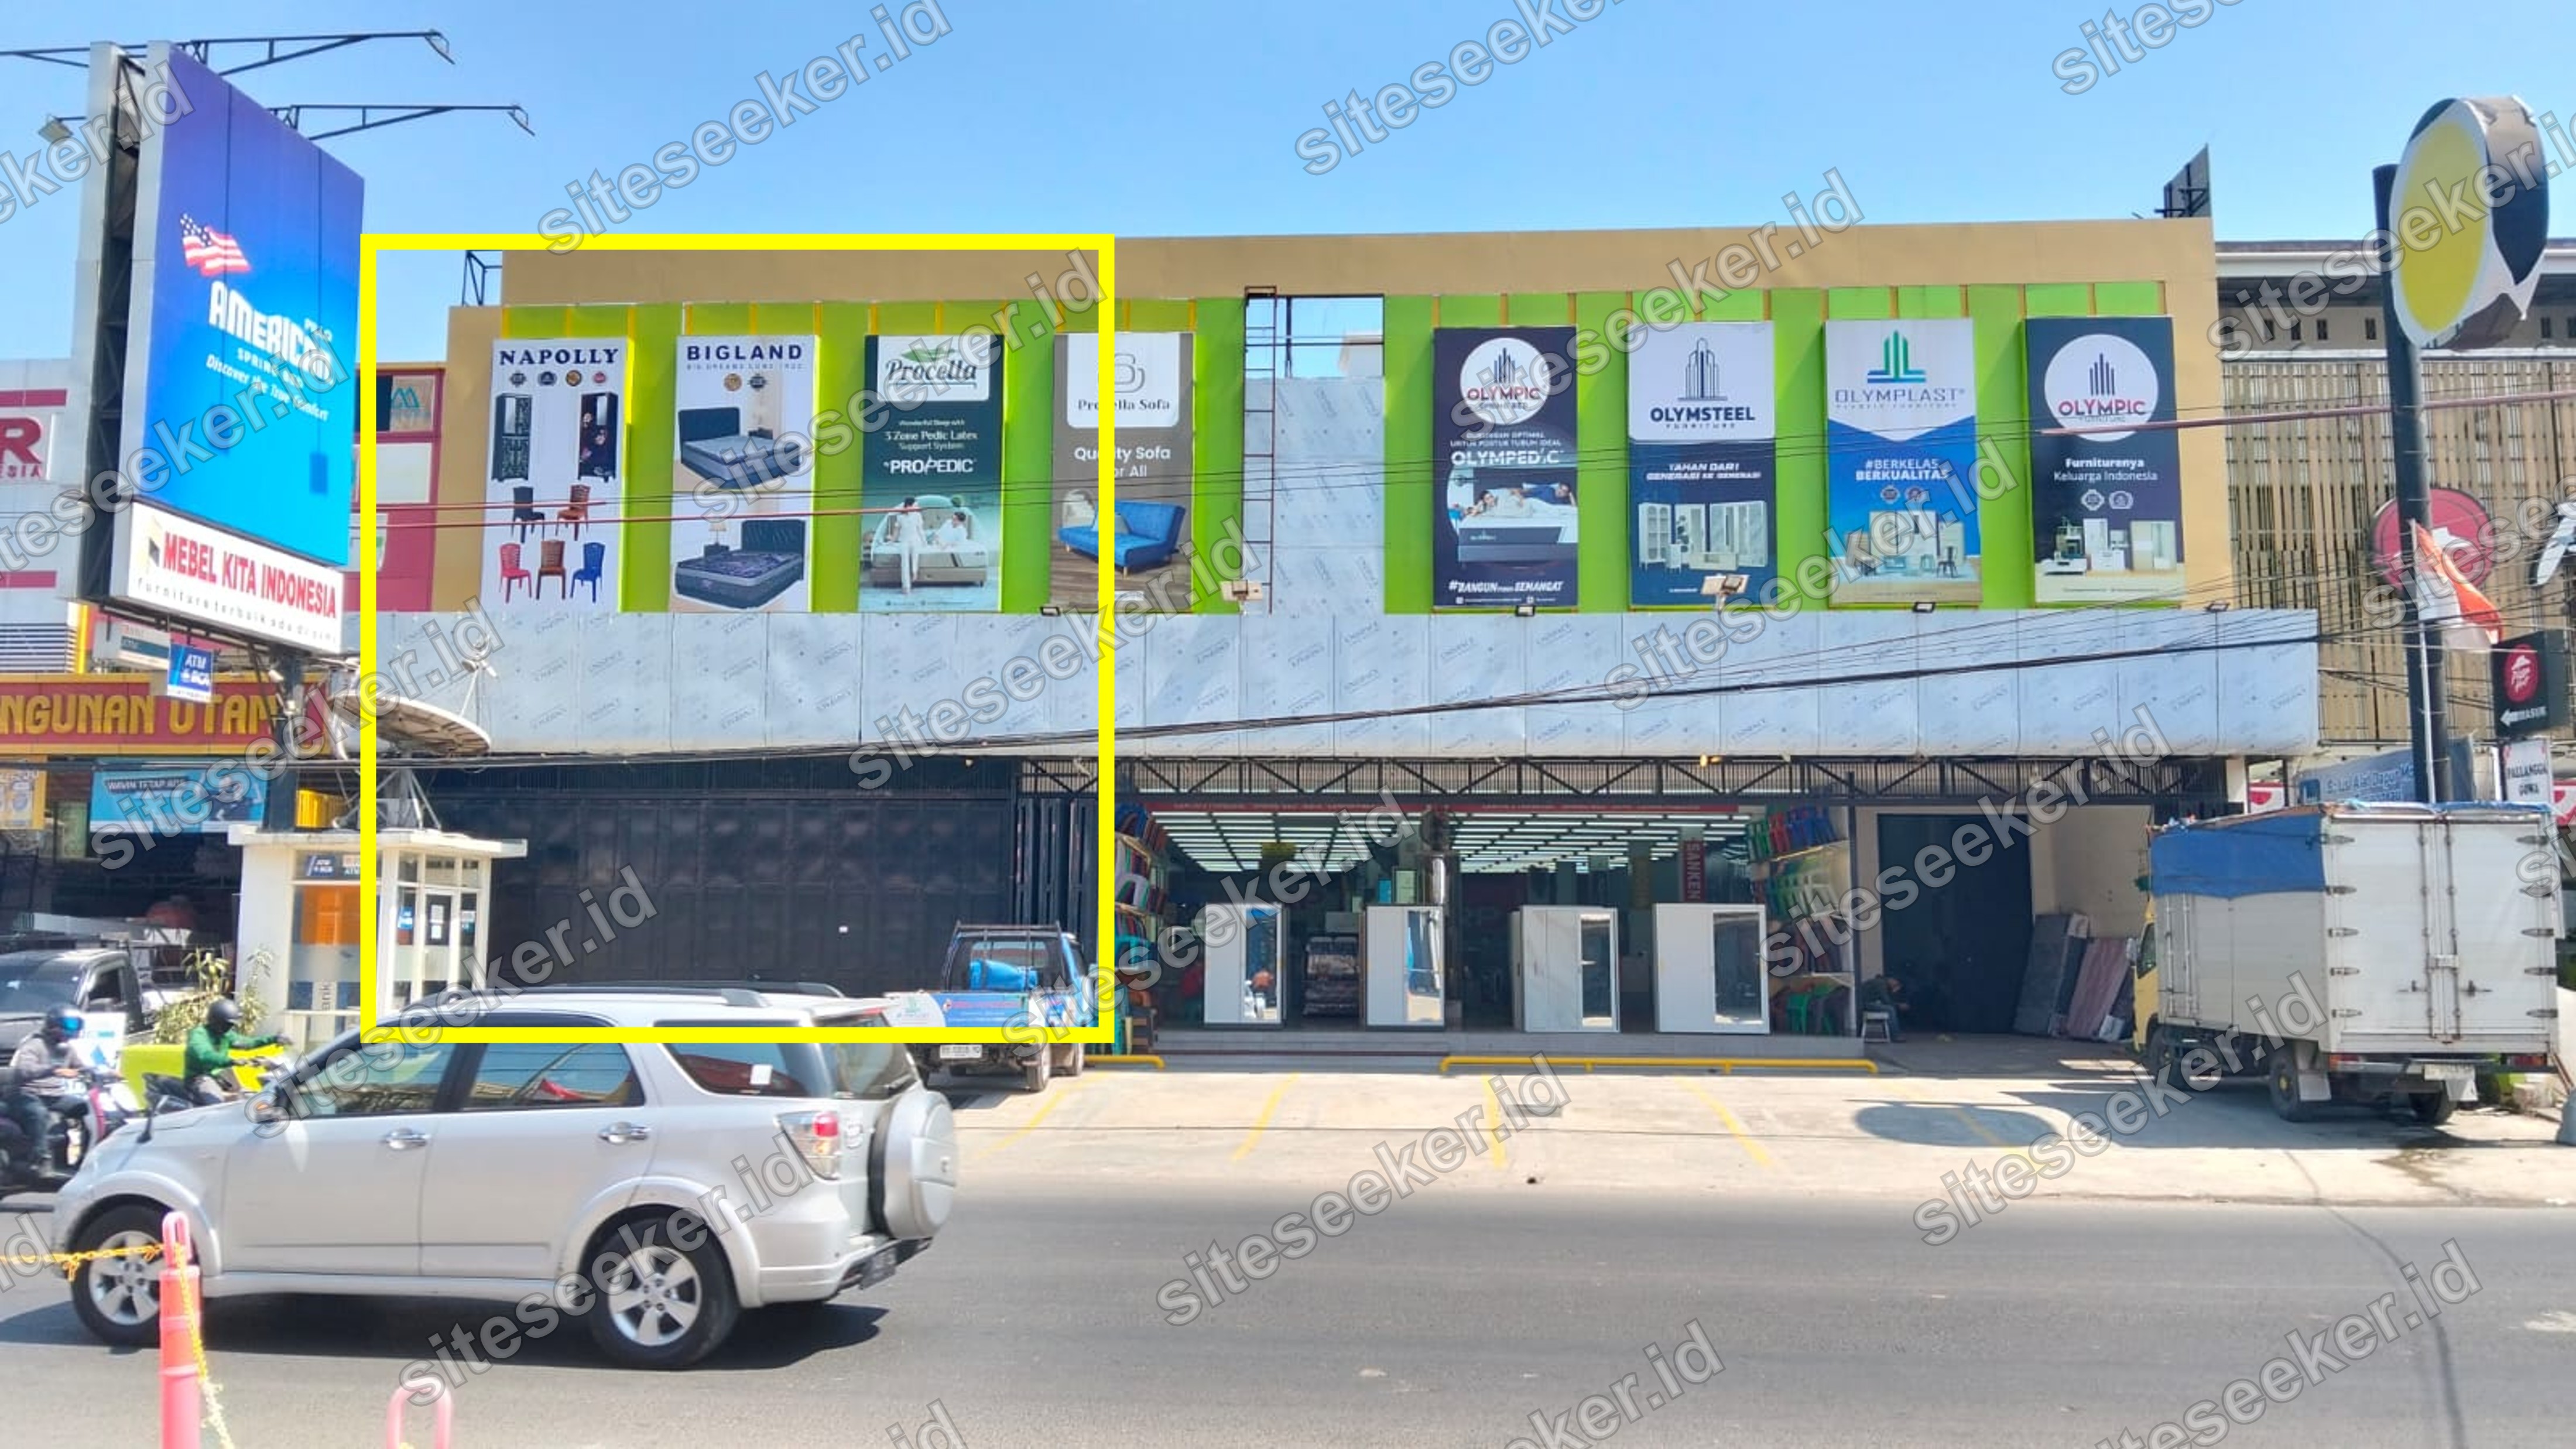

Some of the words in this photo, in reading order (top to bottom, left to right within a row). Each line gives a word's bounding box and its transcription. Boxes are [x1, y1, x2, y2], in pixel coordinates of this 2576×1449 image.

[500, 349, 619, 365] NAPOLLY
[686, 345, 802, 360] BIGLAND
[886, 359, 977, 381] Procella
[1467, 388, 1540, 400] OLYMPIC
[1835, 388, 1959, 403] OLYMPLAST
[1139, 399, 1170, 410] Sofa
[2058, 399, 2147, 416] OLYMPIC
[1650, 407, 1755, 422] OLYMSTEEL
[1136, 446, 1171, 460] Sofa
[1130, 464, 1147, 477] All
[1669, 463, 1707, 471] TAHAN
[1709, 463, 1740, 471] DARI
[1865, 458, 1938, 470] #BERKELAS
[2065, 458, 2145, 470] Furniturenya
[0, 465, 40, 478] SIA
[2053, 471, 2102, 483] Keluarga
[2104, 471, 2159, 481] Indonesia
[163, 531, 217, 584] MEBEL
[221, 550, 257, 596] KITA
[261, 563, 337, 619] INDONESIA
[184, 654, 207, 669] ATM
[1686, 843, 1701, 900] SANKEN
